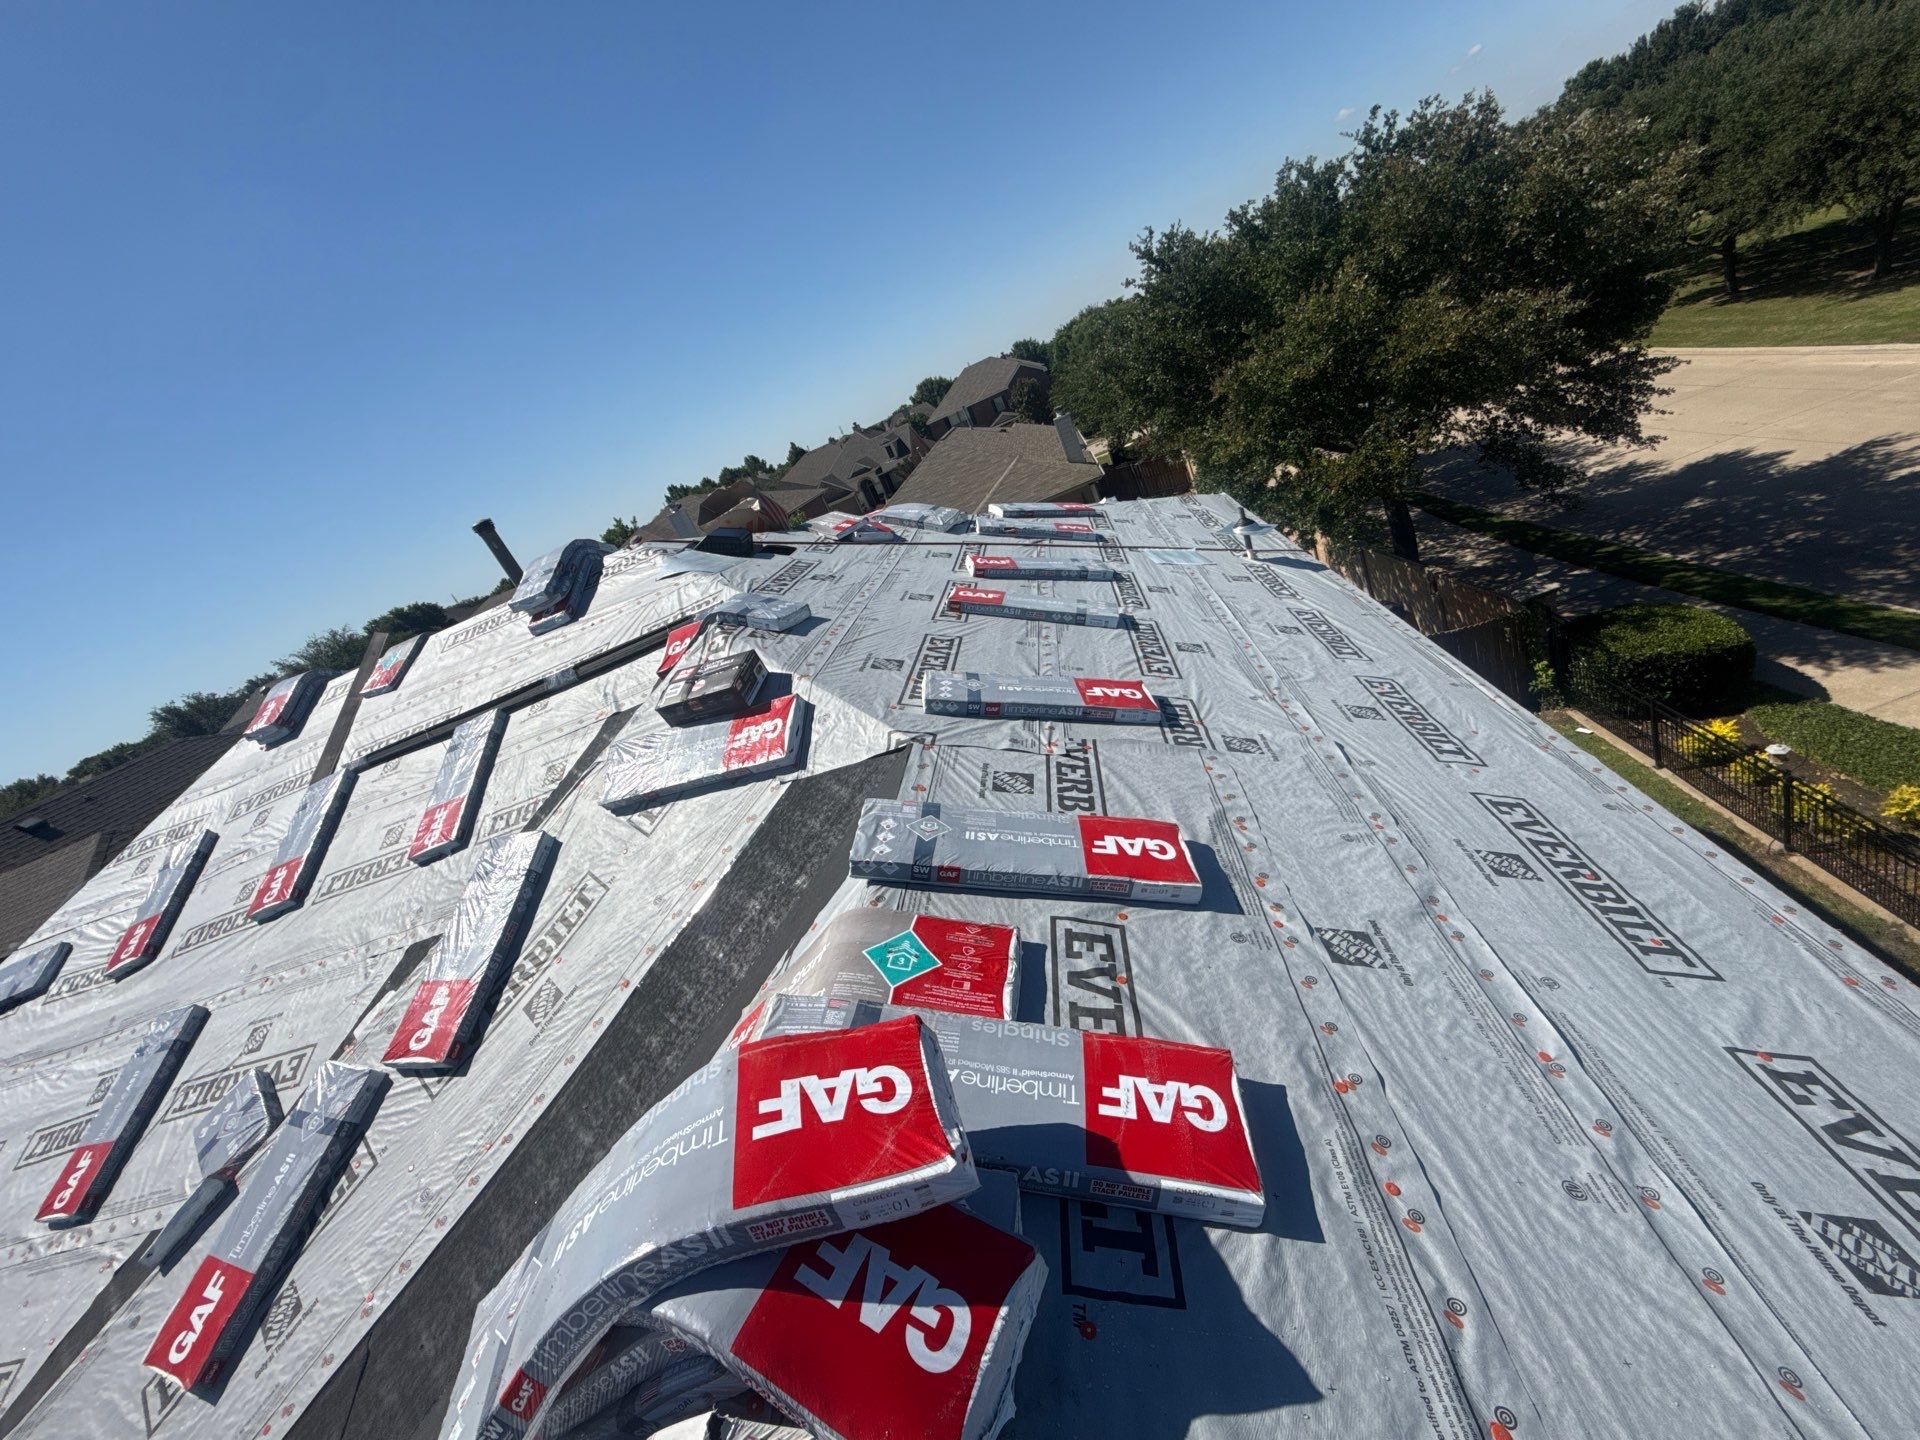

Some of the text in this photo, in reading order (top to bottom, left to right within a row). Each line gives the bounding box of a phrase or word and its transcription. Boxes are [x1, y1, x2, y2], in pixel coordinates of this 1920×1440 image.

[976, 557, 1012, 565] GAF
[957, 590, 1001, 600] GAF
[668, 637, 692, 656] GA
[1295, 610, 1364, 659] EVERBILT
[1003, 702, 1057, 716] Timberline
[1086, 686, 1142, 700] GAF
[1363, 678, 1474, 761] EVERBILT
[998, 832, 1080, 849] Timberline
[1091, 834, 1177, 861] GAF
[263, 868, 288, 904] GAF
[913, 864, 930, 875] SW
[939, 869, 960, 880] GAF
[966, 870, 1047, 887] Timberline
[1485, 798, 1699, 969] EVERBILT
[120, 923, 147, 960] GAF
[408, 984, 451, 1051] GAF
[971, 1020, 1071, 1047] Shingles
[751, 1064, 913, 1142] GAF
[959, 1069, 1080, 1106] Timberline
[1097, 1074, 1229, 1133] GAF
[53, 1150, 93, 1210] GAF
[599, 1119, 729, 1214] Timberline
[1092, 1180, 1152, 1195] DO NOT DOUBLE
[1092, 1187, 1151, 1201] STACK PALLETS
[1342, 1190, 1359, 1218] ASTM
[227, 1188, 278, 1261] Timberline
[753, 1218, 830, 1242] STACK PALLETS
[766, 1217, 786, 1231] NOT
[788, 1210, 826, 1226] DOUBLE
[1750, 1179, 1780, 1210] Only
[1785, 1217, 1813, 1246] The
[1804, 1241, 1848, 1286] Home
[1839, 1281, 1888, 1331] Depot
[168, 1269, 226, 1365] GAF
[793, 1232, 972, 1374] GAF
[1384, 1303, 1405, 1339] D8257
[1398, 1338, 1420, 1375] ASTM
[511, 1379, 534, 1412] GAF
